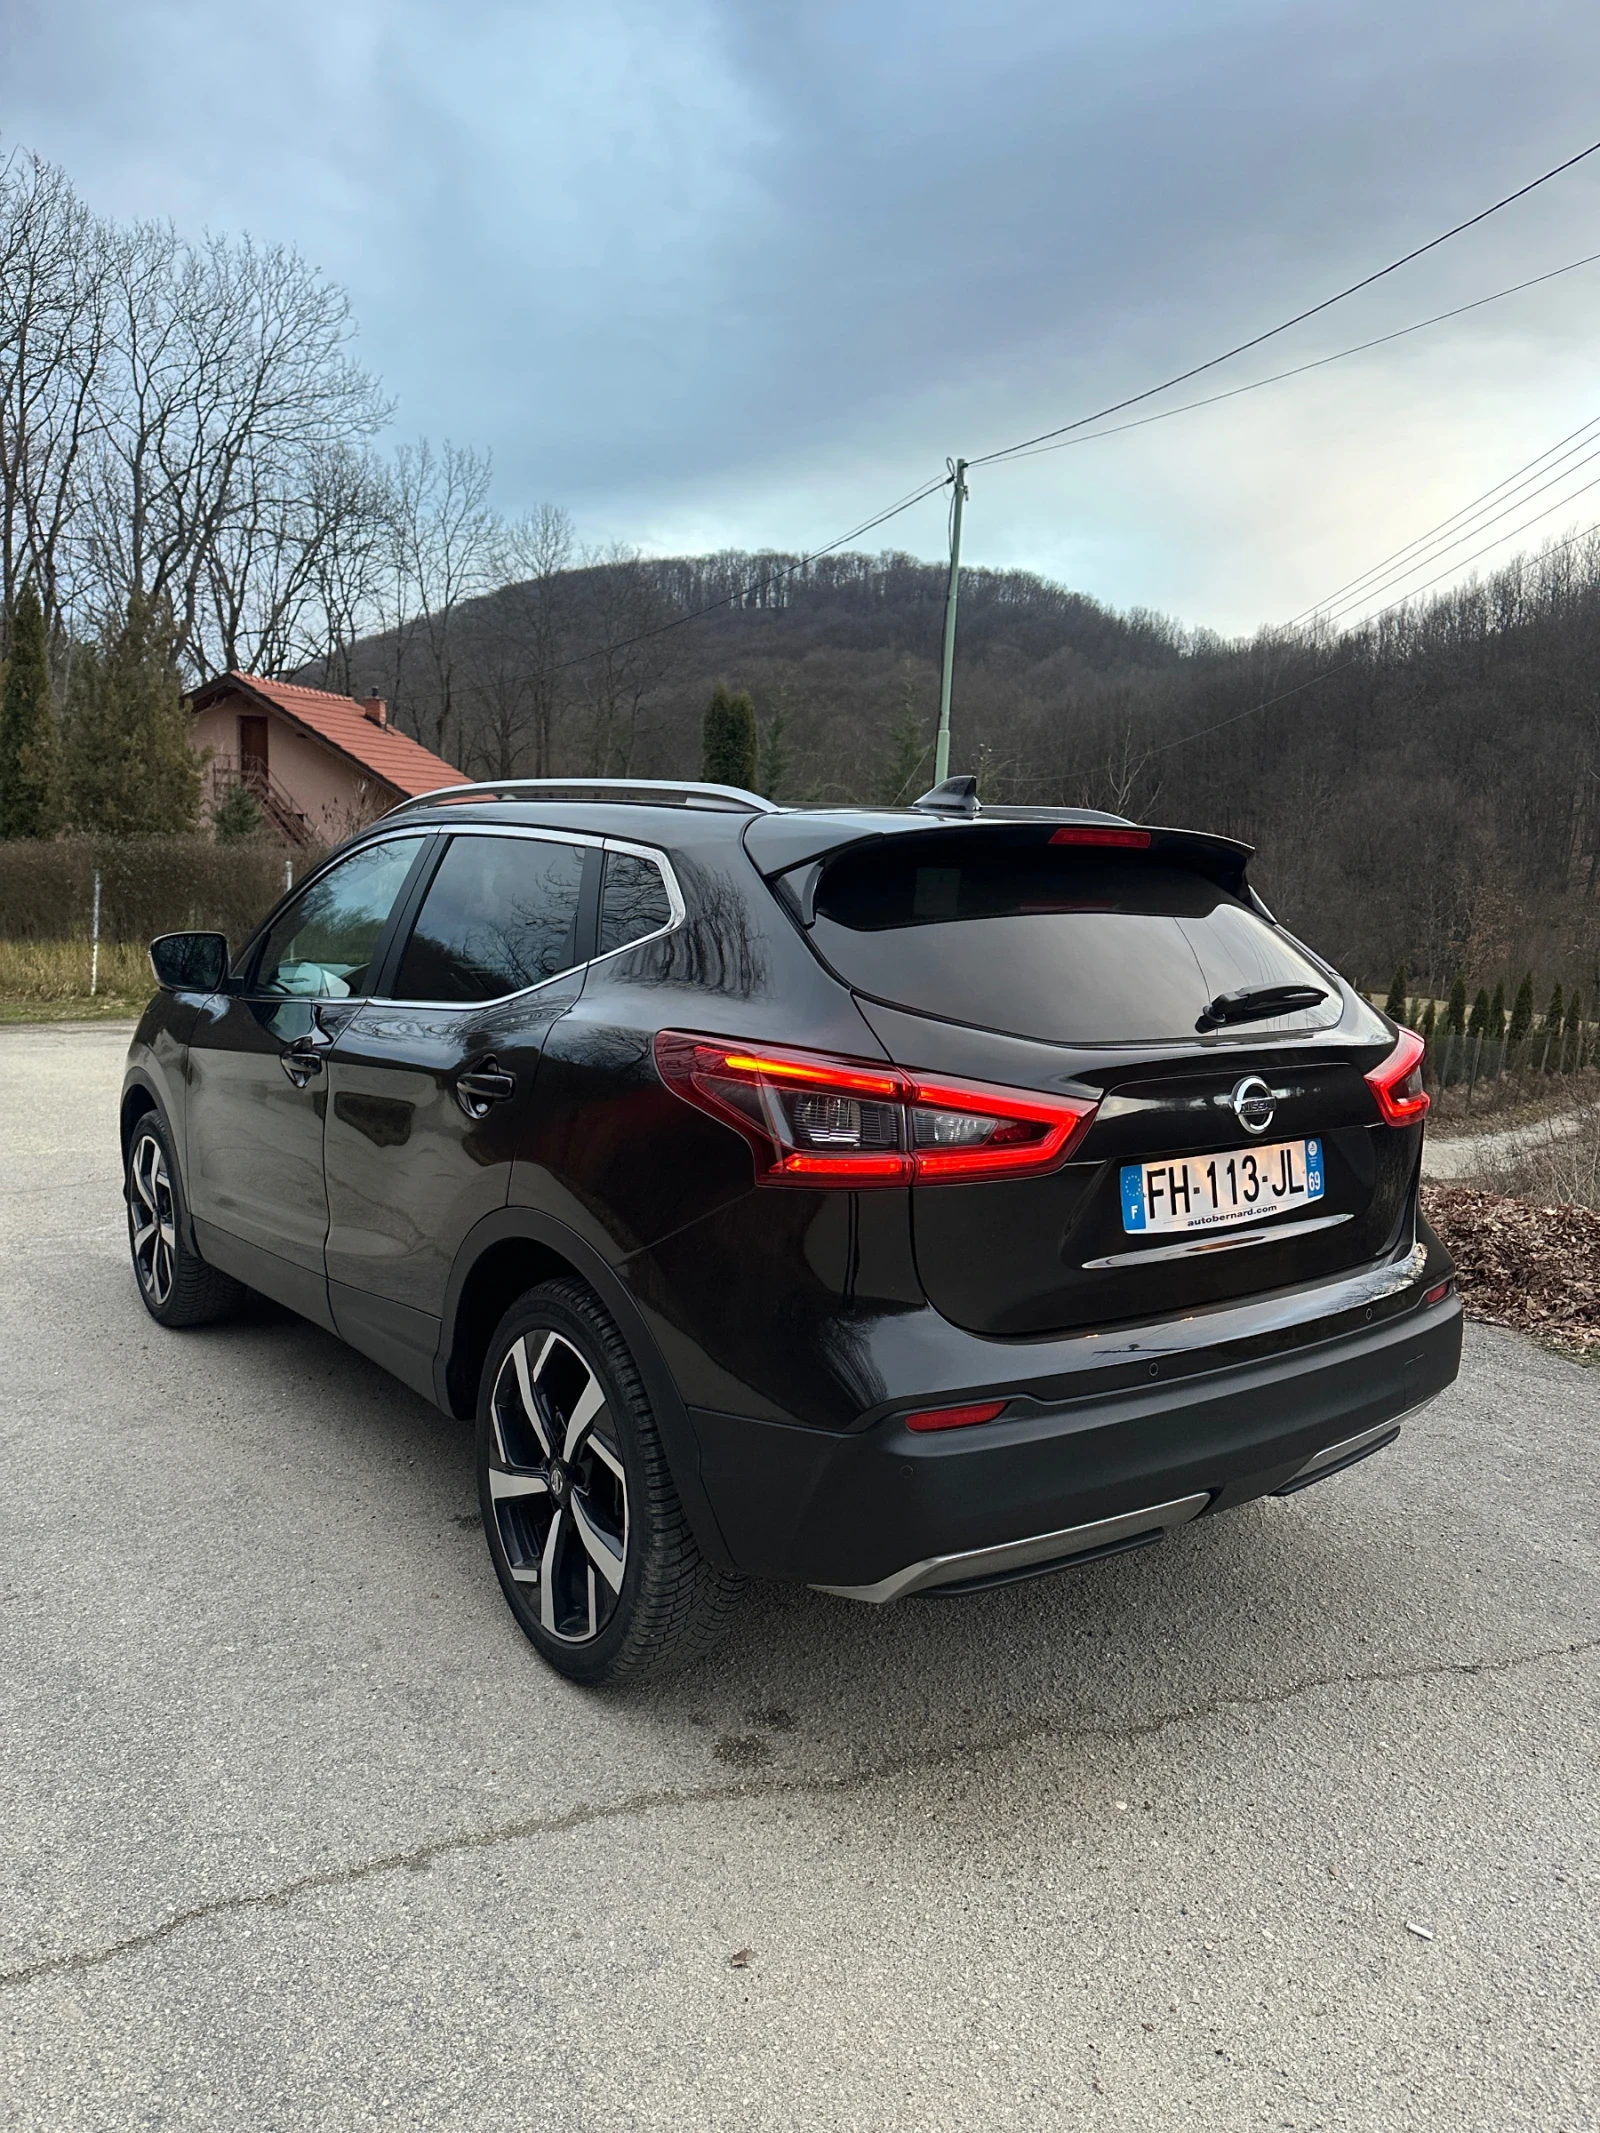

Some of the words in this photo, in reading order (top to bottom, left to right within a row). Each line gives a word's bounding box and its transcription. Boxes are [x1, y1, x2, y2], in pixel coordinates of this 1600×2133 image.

[1147, 1149, 1305, 1219] FH-113-JL
[1309, 1171, 1321, 1192] 69
[1130, 1204, 1139, 1220] F
[1187, 1204, 1277, 1227] autobernard.com
